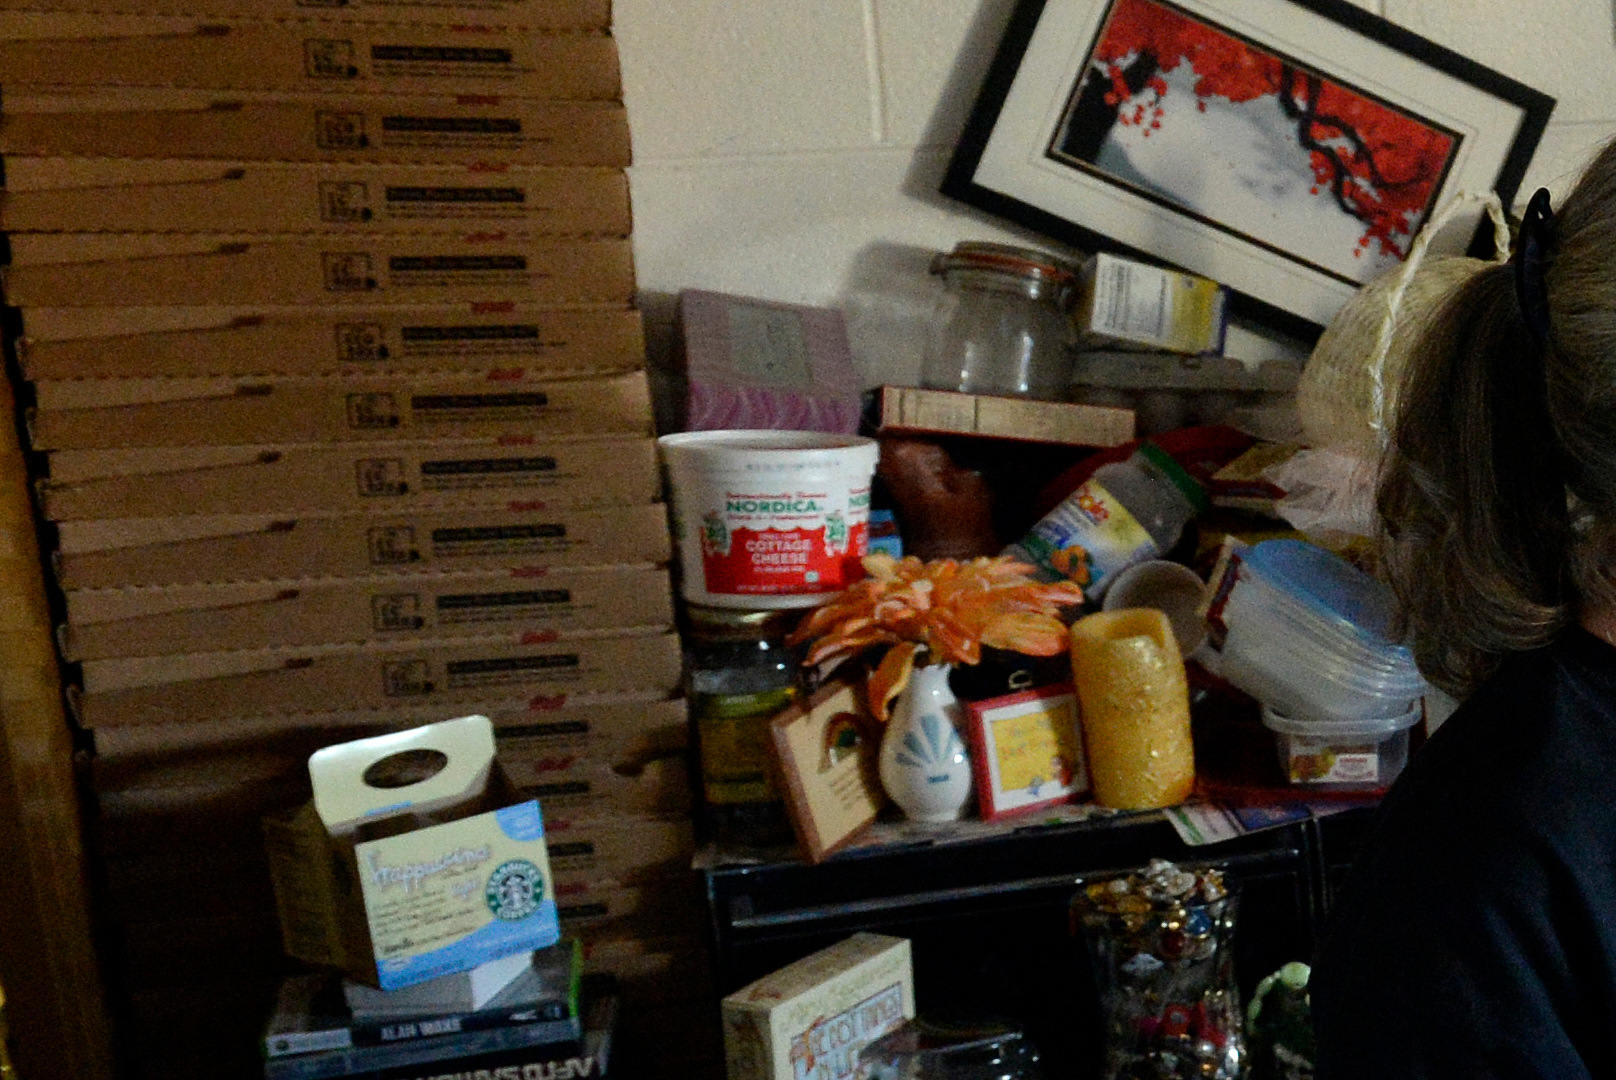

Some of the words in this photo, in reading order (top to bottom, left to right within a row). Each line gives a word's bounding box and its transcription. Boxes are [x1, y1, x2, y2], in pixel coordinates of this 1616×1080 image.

[727, 500, 818, 513] NORDICA
[746, 540, 813, 552] COTTAGE
[752, 553, 807, 565] CHEESE
